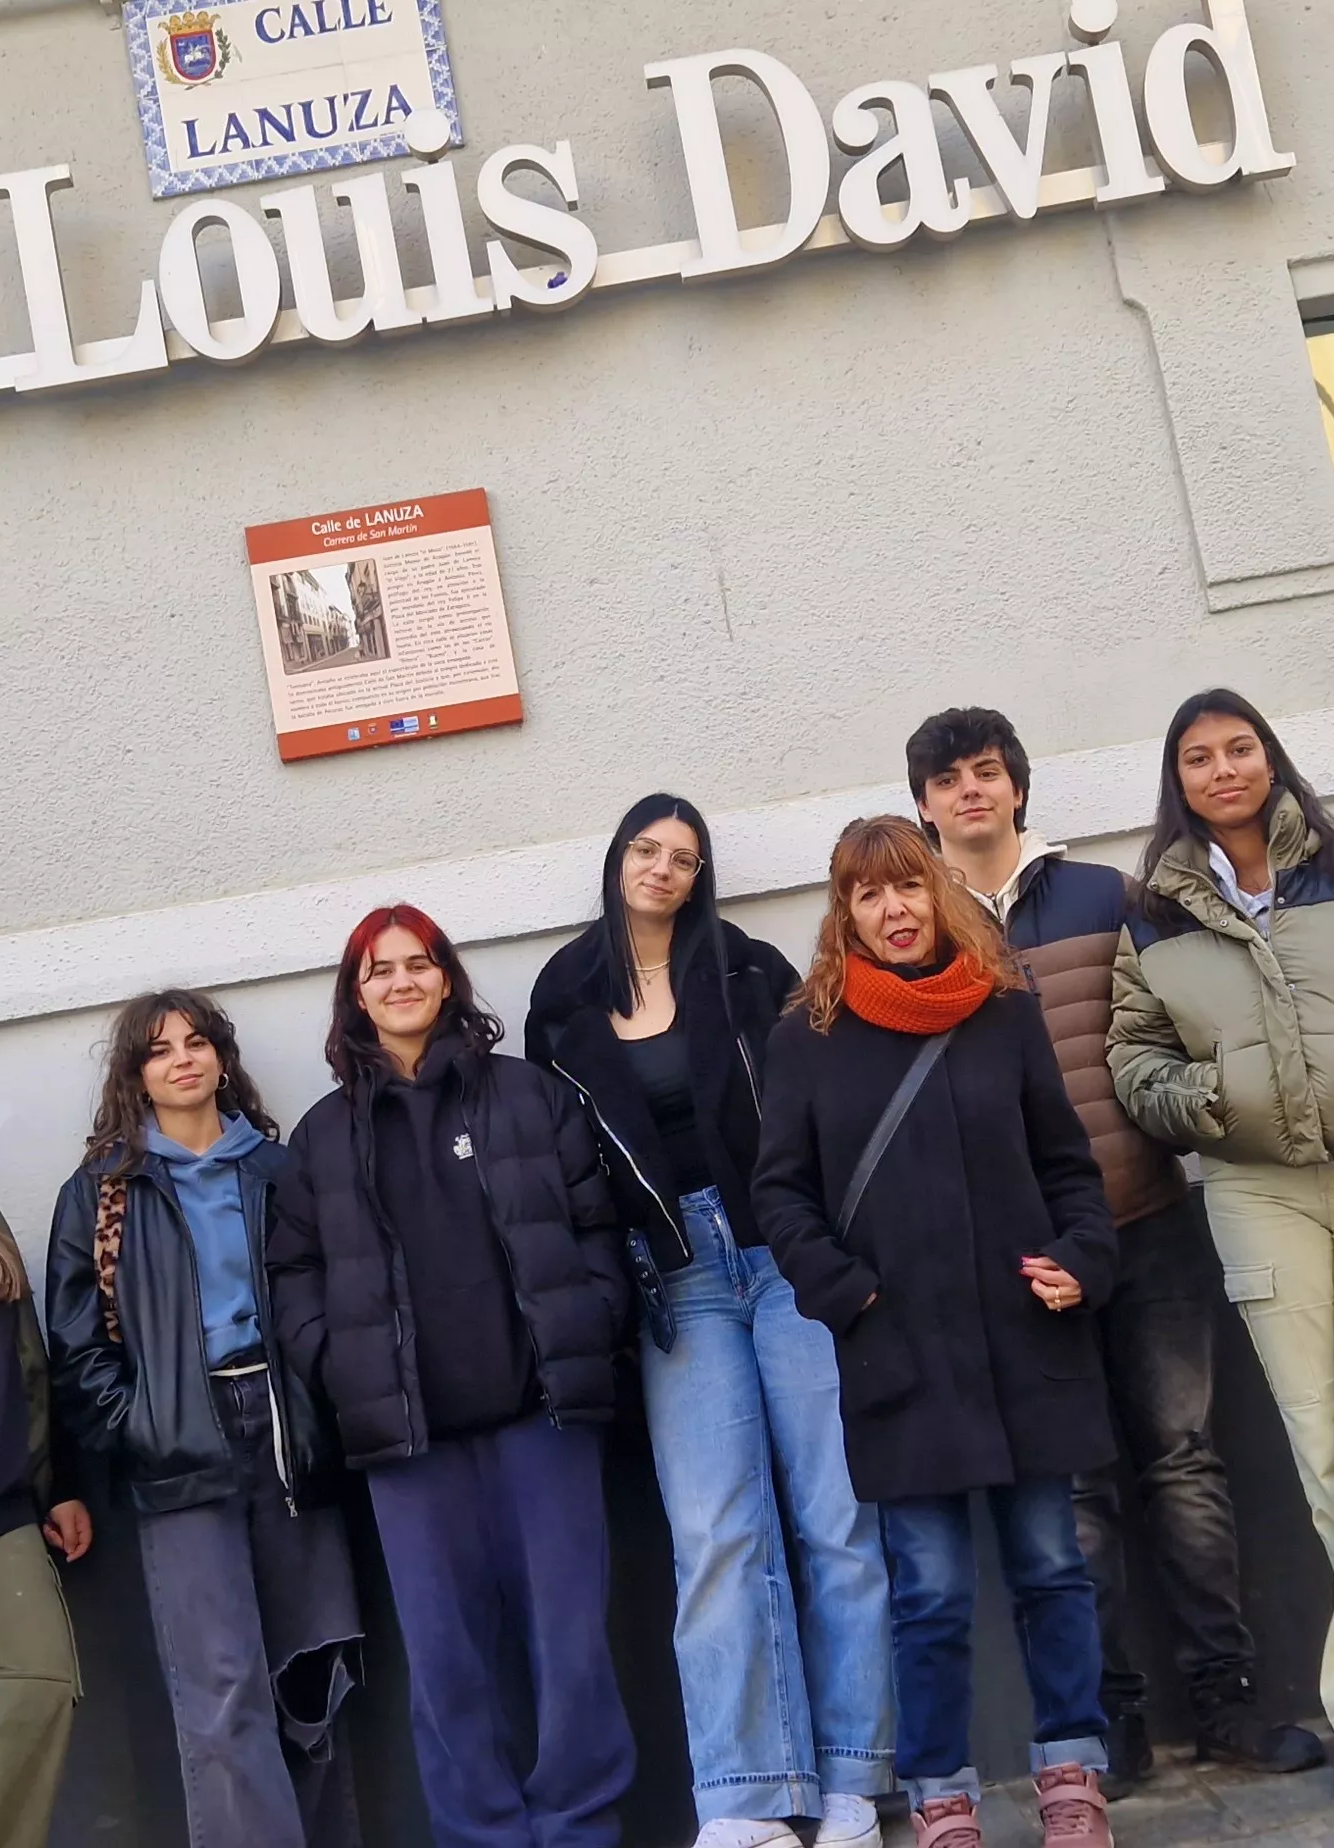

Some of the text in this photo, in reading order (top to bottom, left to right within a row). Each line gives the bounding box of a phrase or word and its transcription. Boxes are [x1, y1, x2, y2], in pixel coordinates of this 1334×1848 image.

[255, 0, 393, 44] CALLE
[181, 83, 413, 160] LANUZA
[644, 0, 1296, 282] David
[311, 504, 424, 536] Calle de LANUZA
[323, 533, 356, 548] Carrera
[357, 531, 368, 542] de
[369, 527, 386, 540] San
